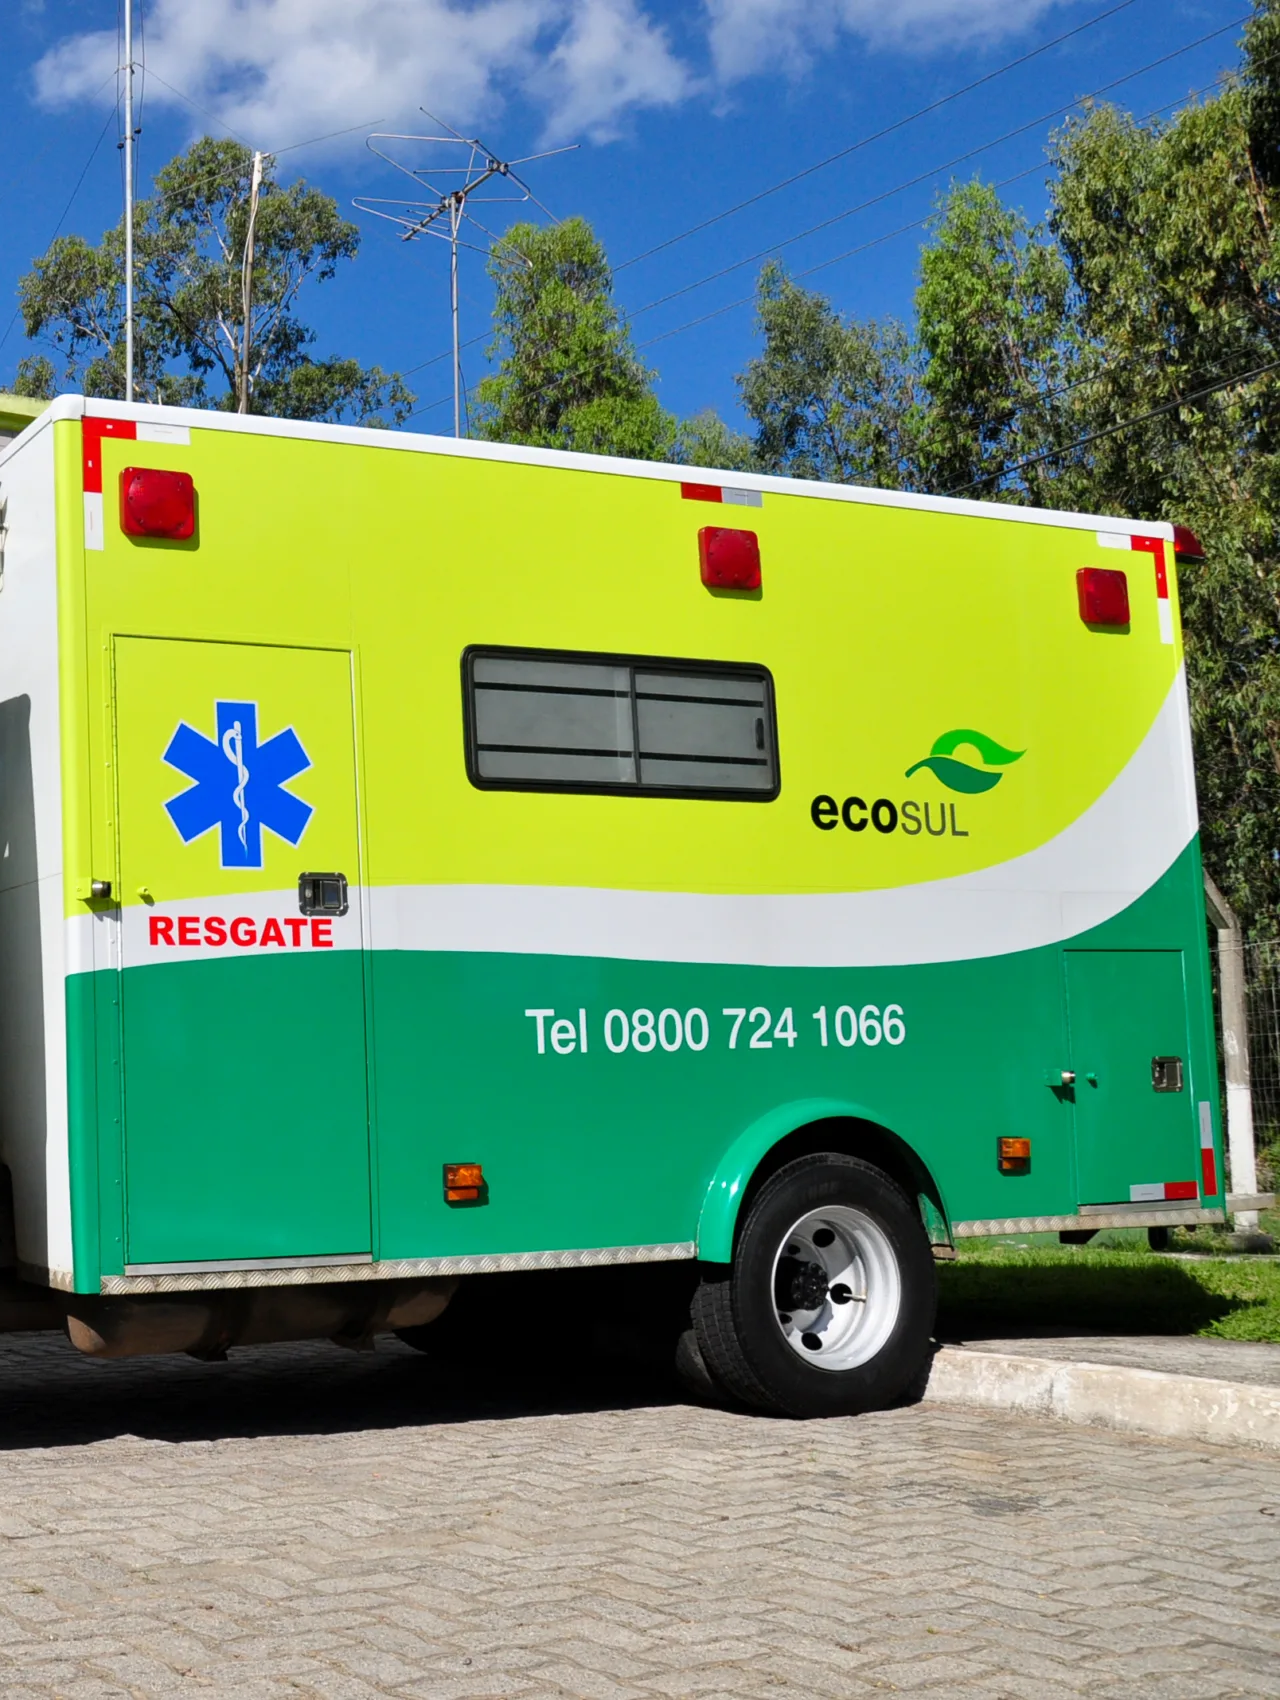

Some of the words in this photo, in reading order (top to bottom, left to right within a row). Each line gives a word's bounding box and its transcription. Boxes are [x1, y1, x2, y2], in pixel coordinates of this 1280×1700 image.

[811, 794, 969, 837] ecoSUL
[148, 916, 335, 948] RESGATE
[525, 1008, 588, 1055] Tel
[604, 1008, 709, 1053] 0800
[722, 1006, 798, 1049] 724
[813, 1004, 907, 1047] 1066
